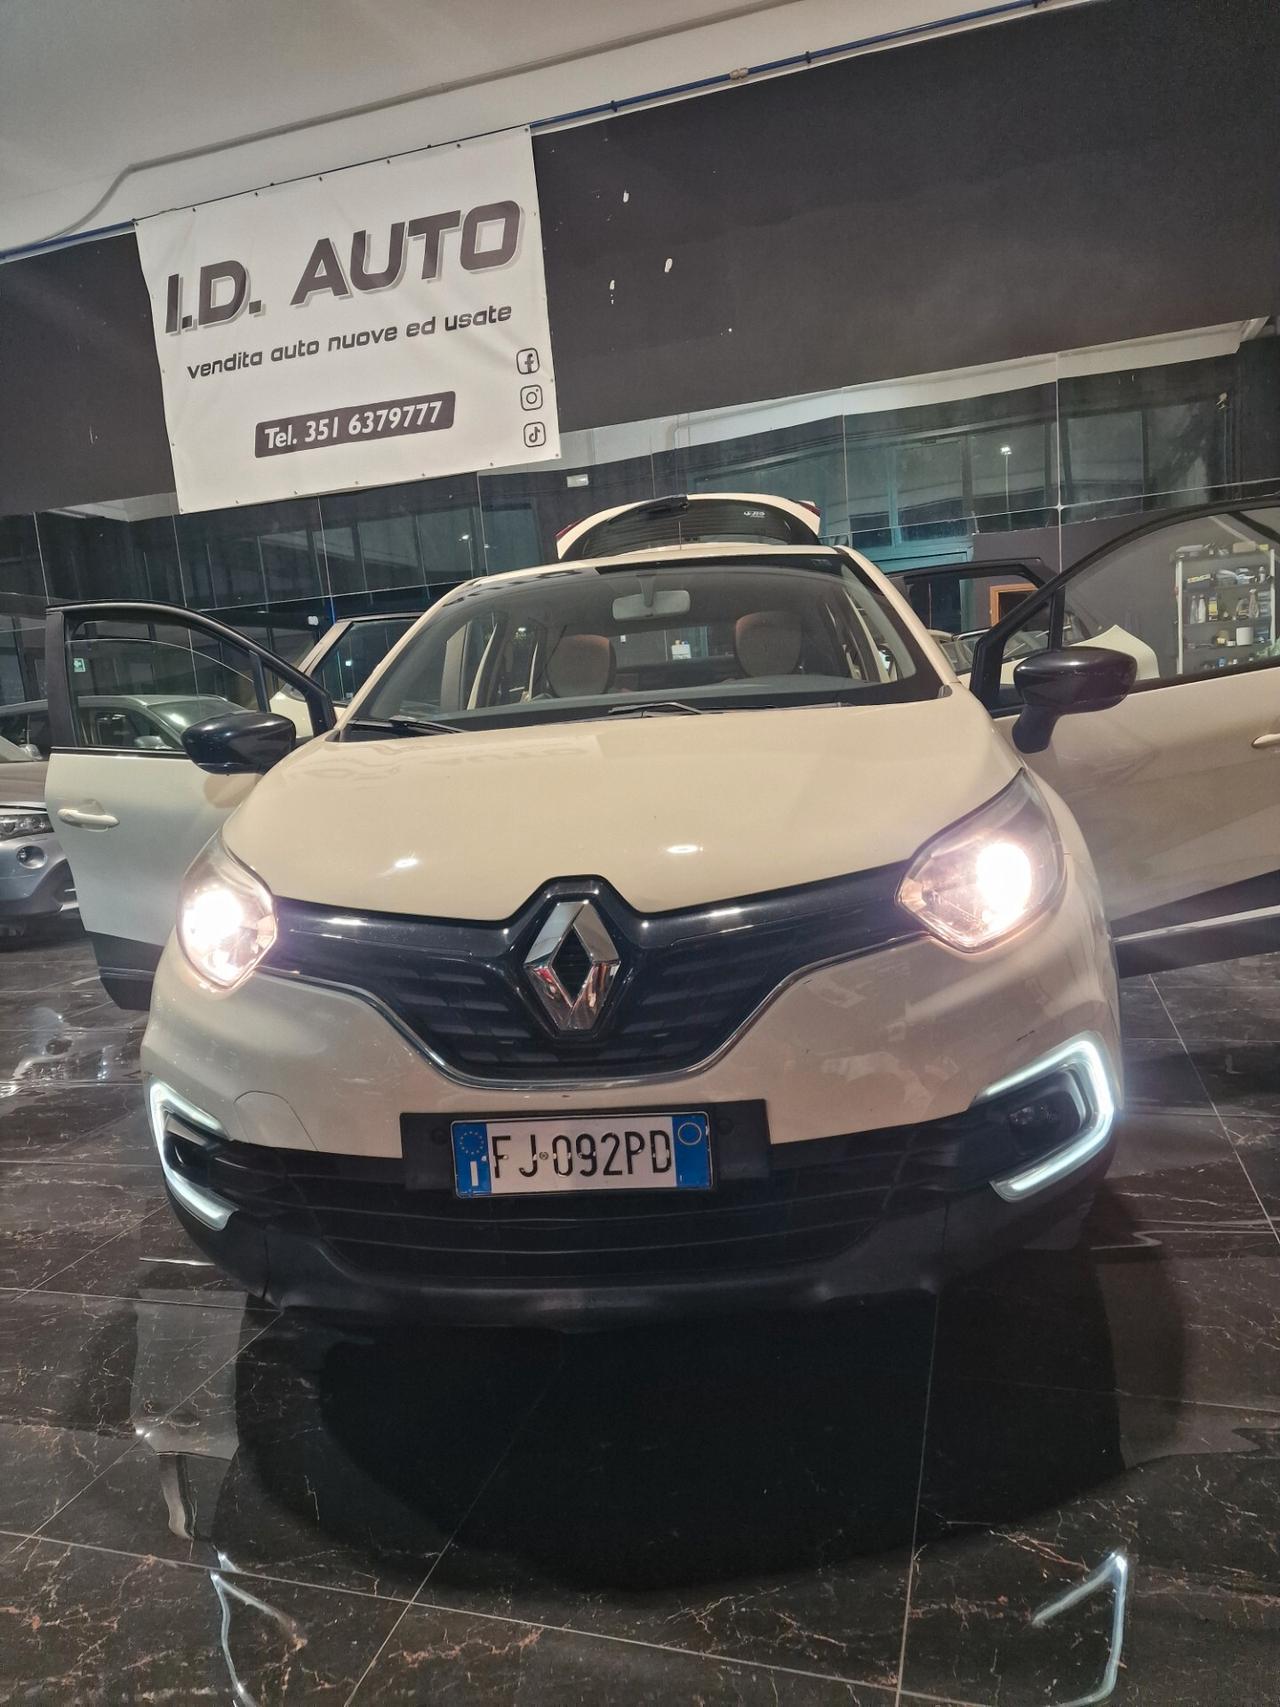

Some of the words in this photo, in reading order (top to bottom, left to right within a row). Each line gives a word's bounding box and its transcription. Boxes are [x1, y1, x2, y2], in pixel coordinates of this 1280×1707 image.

[165, 260, 265, 335] I.D.
[290, 200, 524, 306] AUTO
[187, 350, 263, 379] vendita
[270, 340, 320, 362] auto
[328, 325, 397, 351] nuove
[406, 316, 436, 337] ed
[444, 303, 512, 331] usate
[264, 427, 297, 449] Tel.
[304, 416, 339, 442] 351
[348, 400, 443, 435] 6379777
